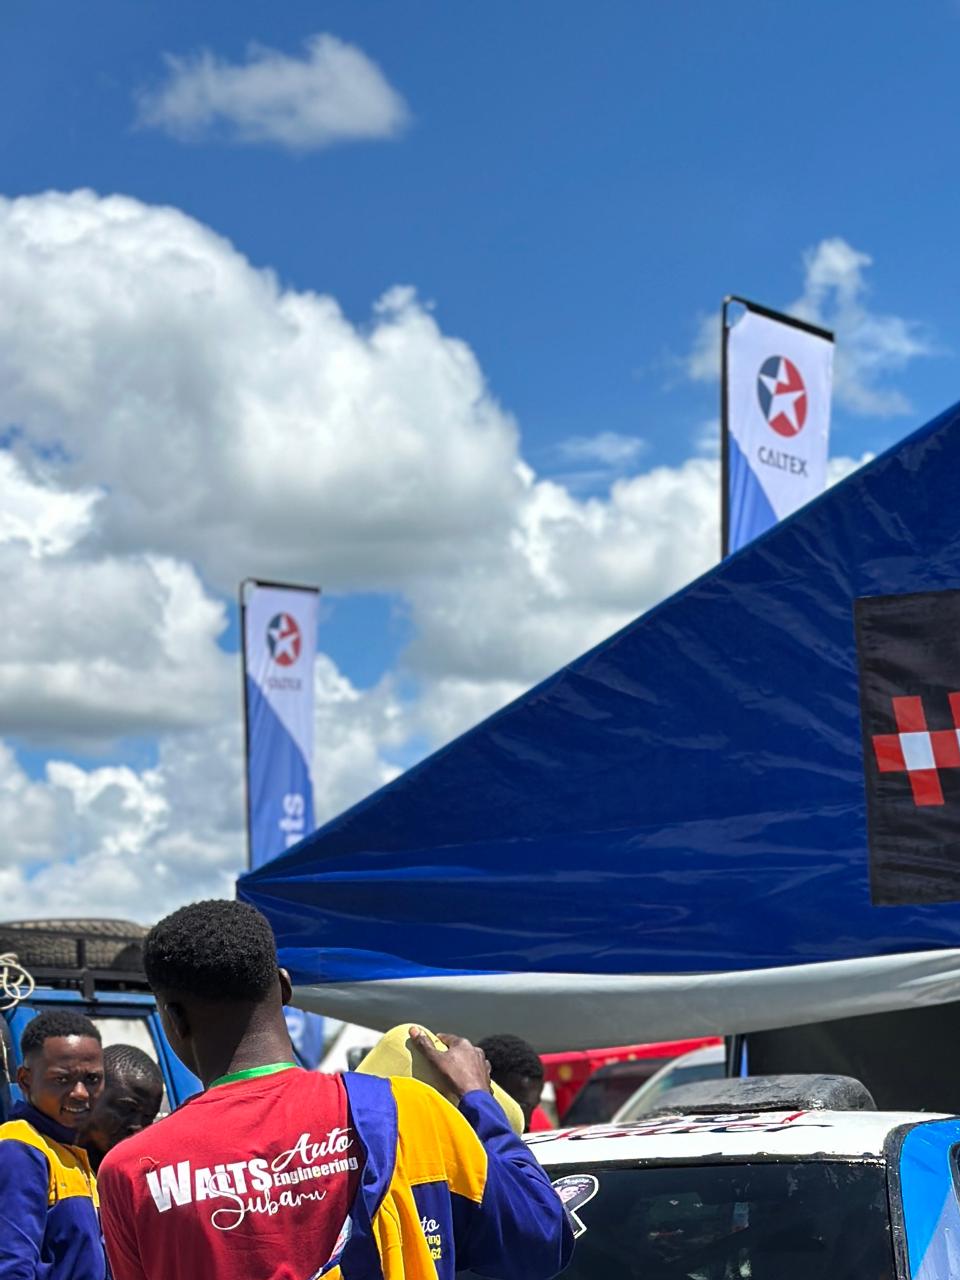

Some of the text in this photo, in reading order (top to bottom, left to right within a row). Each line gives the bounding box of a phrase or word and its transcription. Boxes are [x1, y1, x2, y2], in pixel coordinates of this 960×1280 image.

[758, 446, 808, 478] CALTEX
[271, 1127, 353, 1172] Auto
[273, 1157, 358, 1188] Engineering
[208, 1172, 327, 1231] Subaru
